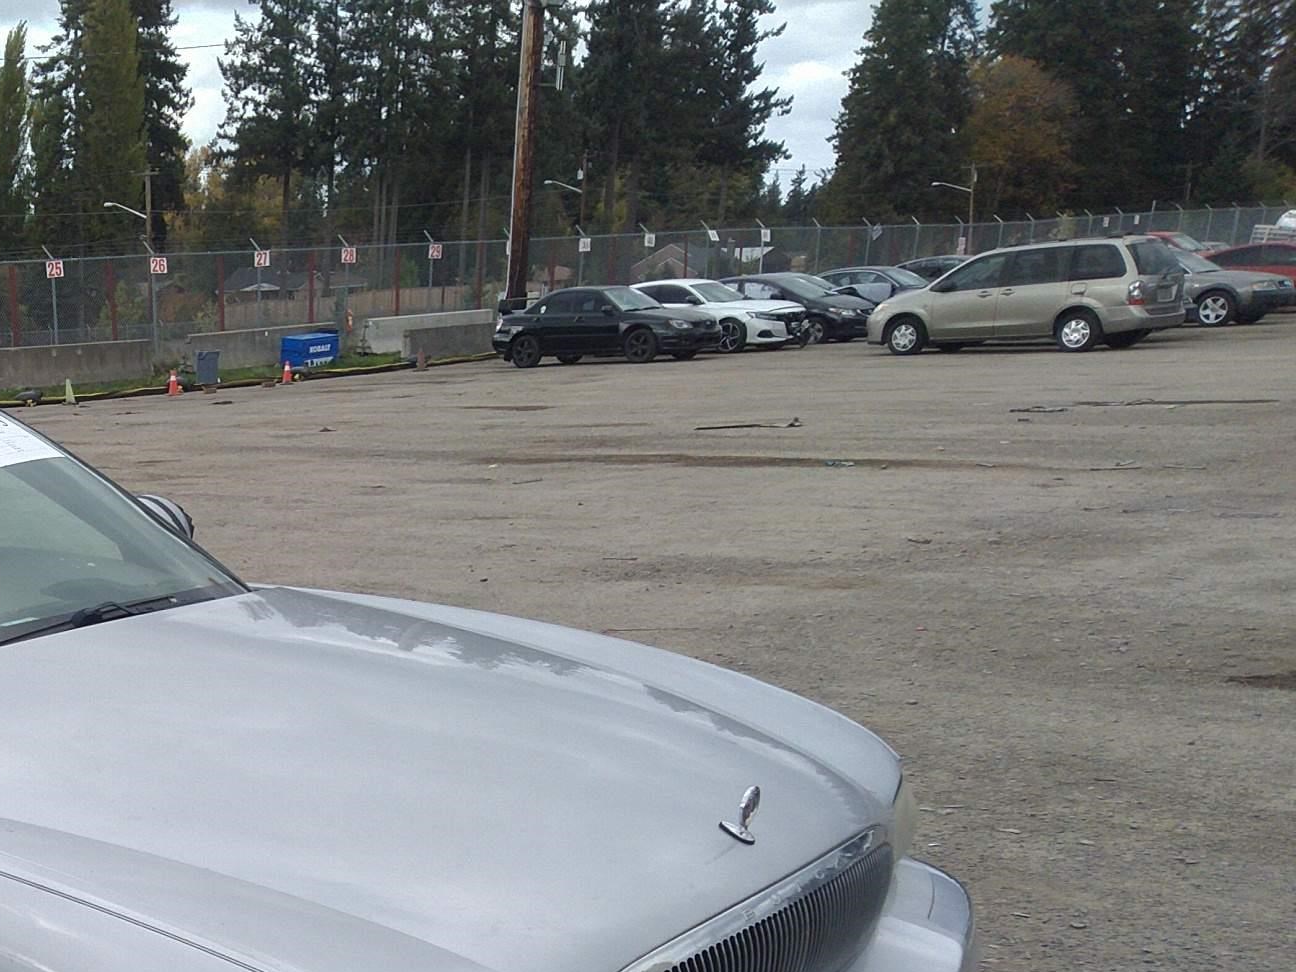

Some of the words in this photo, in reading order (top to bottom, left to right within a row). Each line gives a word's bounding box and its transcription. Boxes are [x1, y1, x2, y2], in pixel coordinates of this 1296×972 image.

[256, 251, 267, 265] 27
[343, 248, 354, 262] 28
[430, 244, 442, 258] 29
[47, 261, 62, 277] 25
[151, 258, 166, 273] 26
